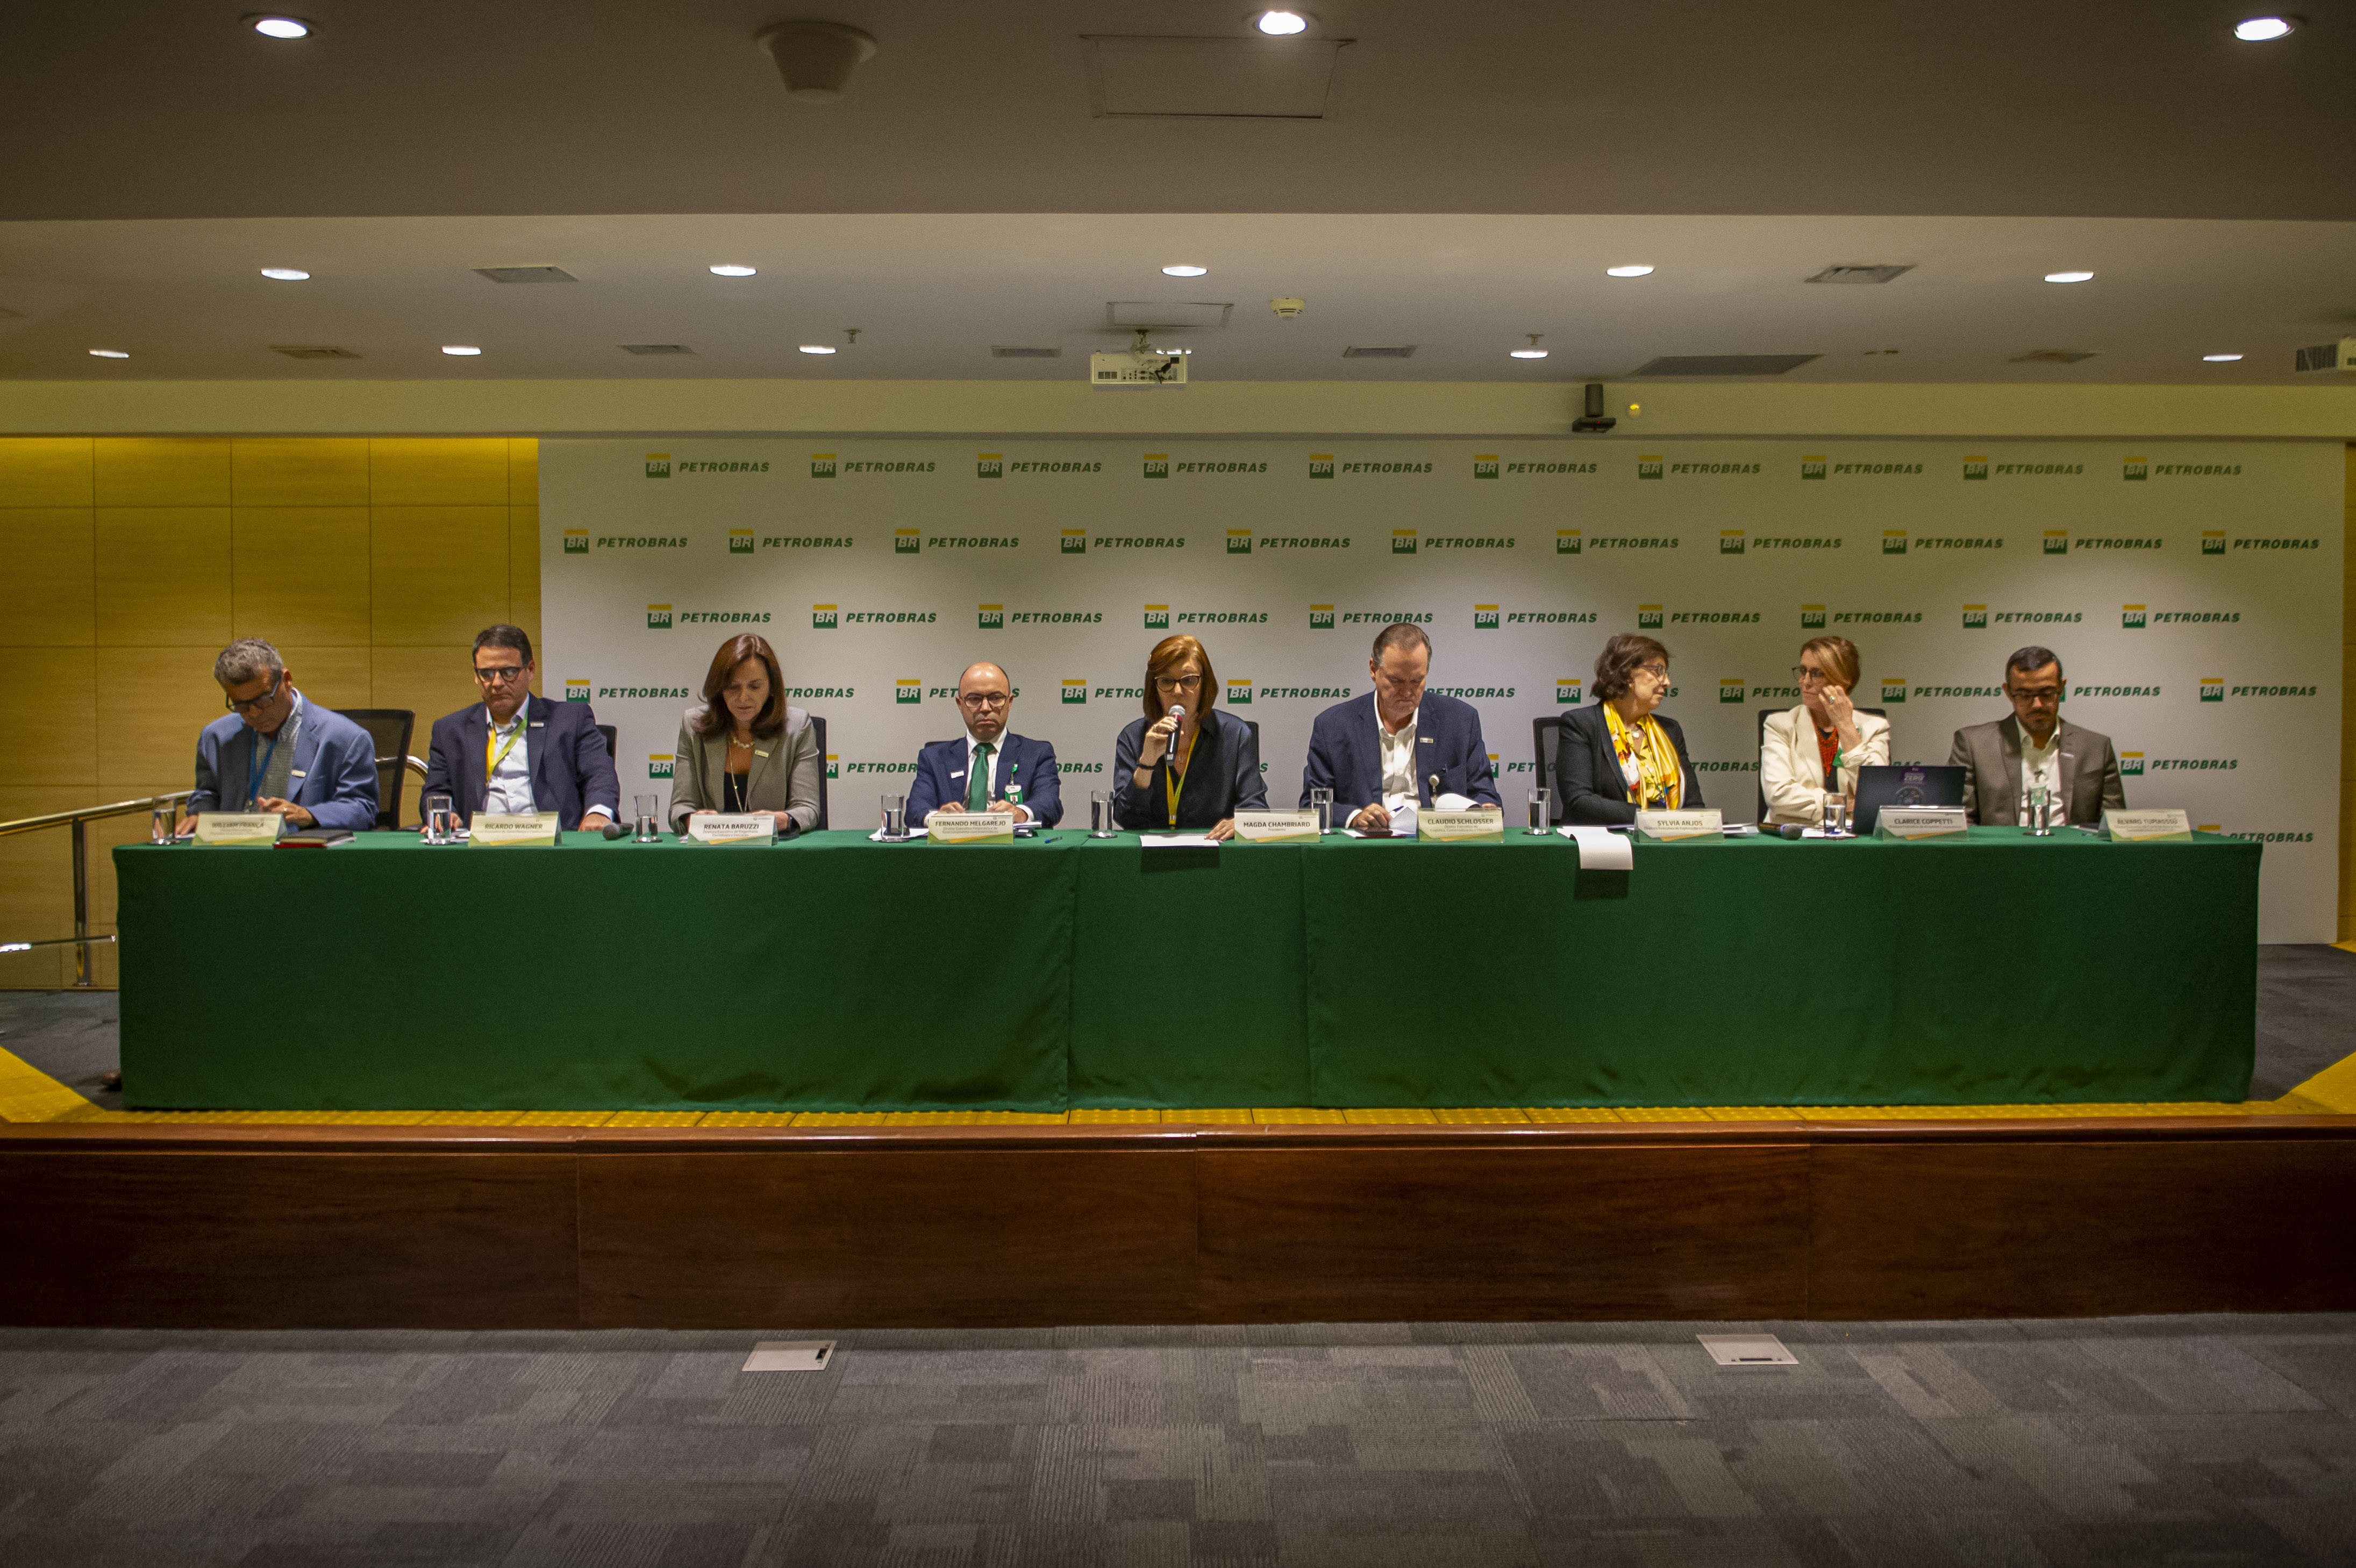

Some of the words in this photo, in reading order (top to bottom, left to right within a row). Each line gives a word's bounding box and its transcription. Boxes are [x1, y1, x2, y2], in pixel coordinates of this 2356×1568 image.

[679, 462, 769, 472] PETROBRAS
[845, 462, 936, 472] PETROBRAS
[1011, 462, 1102, 472] PETROBRAS
[1177, 462, 1267, 472] PETROBRAS
[1342, 462, 1433, 472] PETROBRAS
[1507, 463, 1597, 473] PETROBRAS
[1671, 463, 1761, 474] PETROBRAS
[1834, 464, 1924, 474] PETROBRAS
[1996, 464, 2083, 475] PETROBRAS
[2155, 465, 2241, 475] PETROBRAS
[597, 538, 688, 548] PETROBRAS
[762, 538, 853, 548] PETROBRAS
[928, 538, 1019, 548] PETROBRAS
[1094, 538, 1185, 548] PETROBRAS
[1260, 538, 1351, 548] PETROBRAS
[1425, 538, 1515, 548] PETROBRAS
[1589, 538, 1679, 548] PETROBRAS
[1753, 538, 1841, 548] PETROBRAS
[1915, 538, 2003, 548] PETROBRAS
[2076, 539, 2163, 548] PETROBRAS
[2234, 539, 2320, 549] PETROBRAS
[680, 612, 771, 623] PETROBRAS
[846, 612, 937, 623] PETROBRAS
[1011, 612, 1103, 623] PETROBRAS
[1177, 612, 1268, 623] PETROBRAS
[1343, 612, 1433, 623] PETROBRAS
[1507, 612, 1597, 623] PETROBRAS
[1672, 612, 1761, 623] PETROBRAS
[1834, 612, 1923, 623] PETROBRAS
[1995, 612, 2083, 623] PETROBRAS
[2154, 612, 2241, 623] PETROBRAS
[598, 688, 689, 698] PETROBRAS
[785, 688, 854, 698] TROBRAS
[1095, 688, 1145, 698] PETRO
[1260, 688, 1351, 698] PETROBRAS
[1752, 687, 1801, 698] PETRO
[1914, 686, 2002, 697] PETROBRAS
[2074, 686, 2161, 697] PETROBRAS
[2231, 686, 2317, 697] PETROBRAS
[847, 763, 918, 774] PETROBR
[1690, 762, 1759, 772] TROBRAS
[2152, 760, 2238, 770] PETROBRAS
